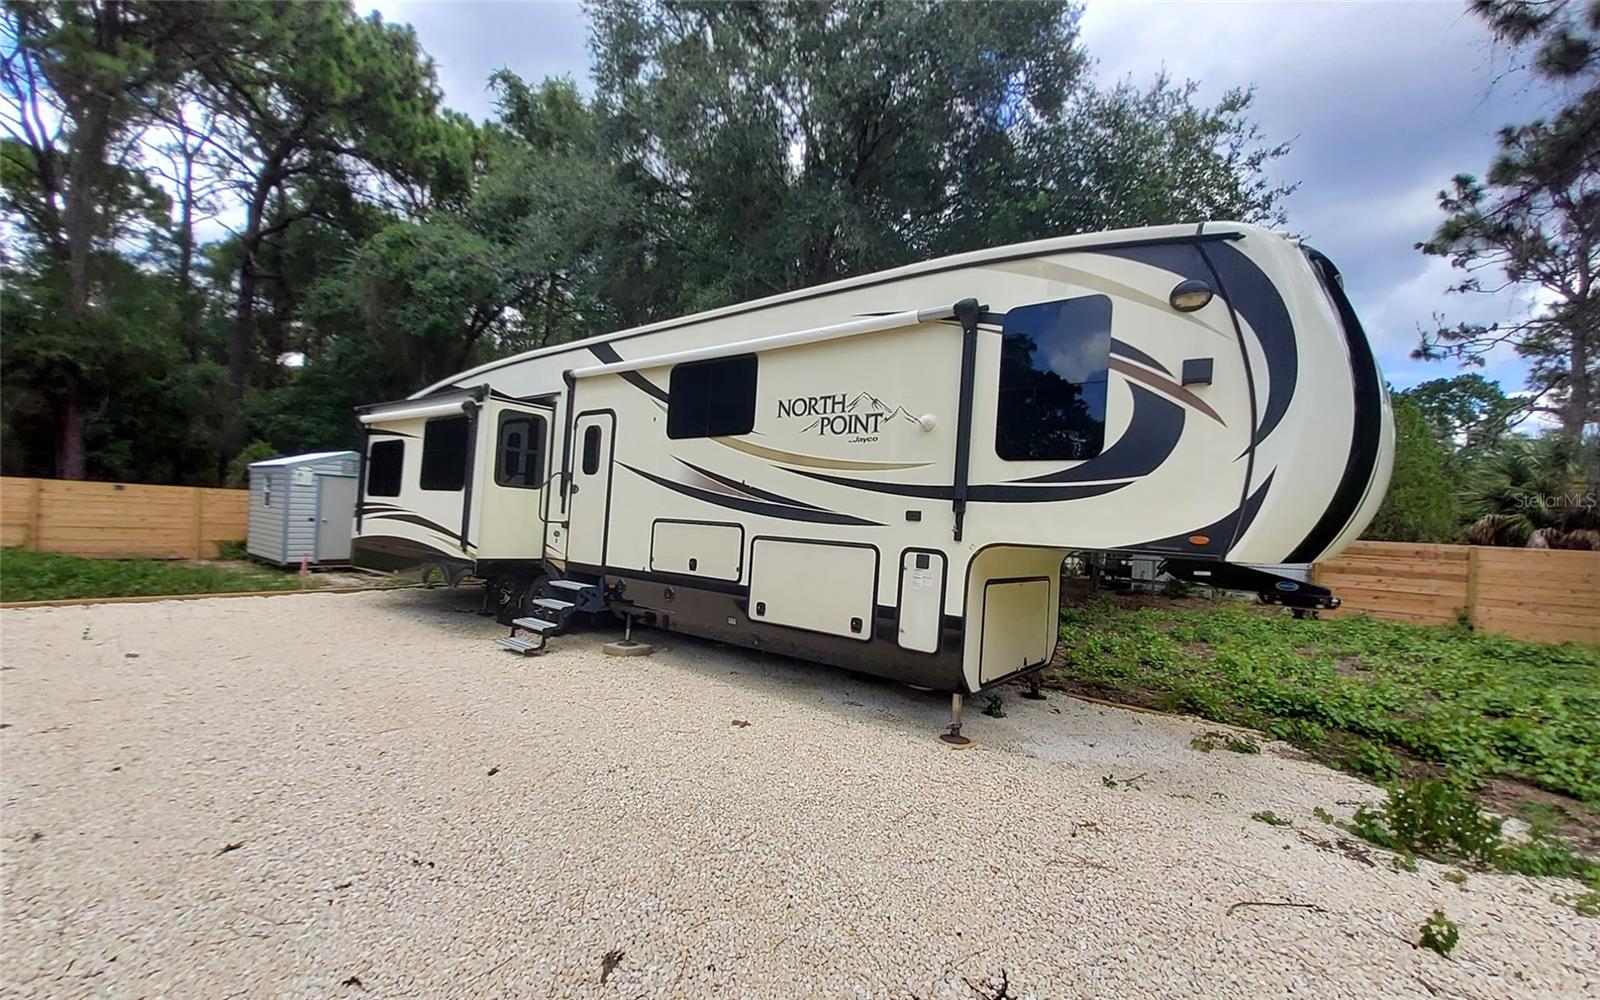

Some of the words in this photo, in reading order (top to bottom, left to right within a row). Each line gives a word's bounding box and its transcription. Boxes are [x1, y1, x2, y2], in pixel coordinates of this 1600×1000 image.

[777, 393, 848, 418] NORTH
[819, 413, 884, 436] POINT
[853, 435, 879, 443] Jayco
